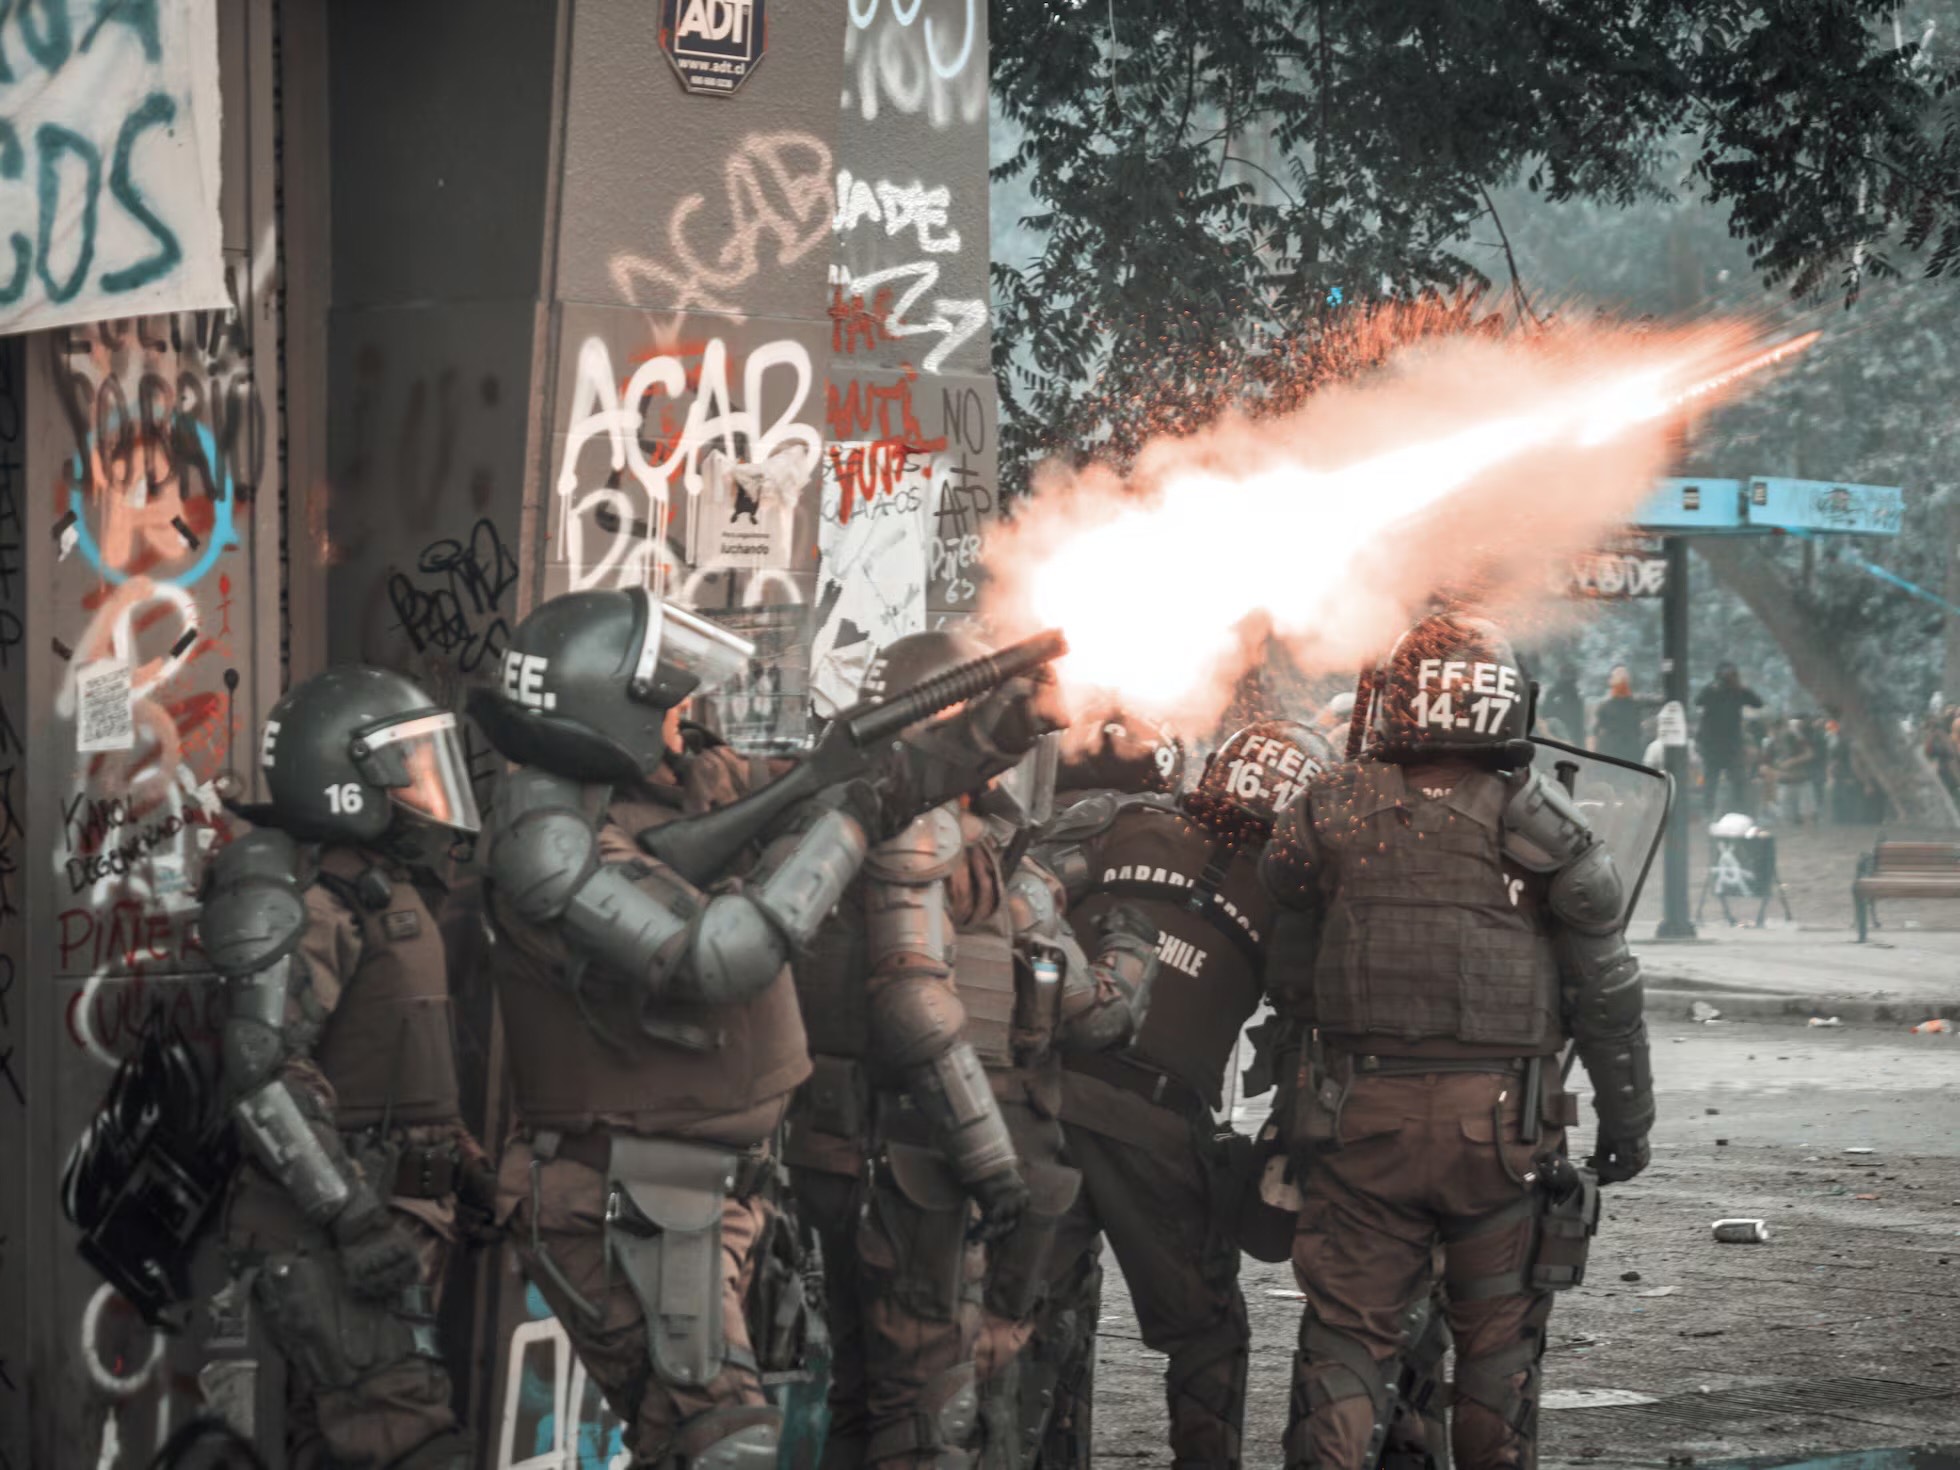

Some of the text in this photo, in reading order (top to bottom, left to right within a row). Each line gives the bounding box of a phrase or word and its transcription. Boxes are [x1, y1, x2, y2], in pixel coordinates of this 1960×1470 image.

[677, 0, 750, 43] ADT
[557, 336, 822, 497] ACAB
[942, 387, 985, 455] NO
[1418, 659, 1521, 703] FF.EE.
[1411, 691, 1512, 736] 14-17
[324, 783, 363, 813] 16
